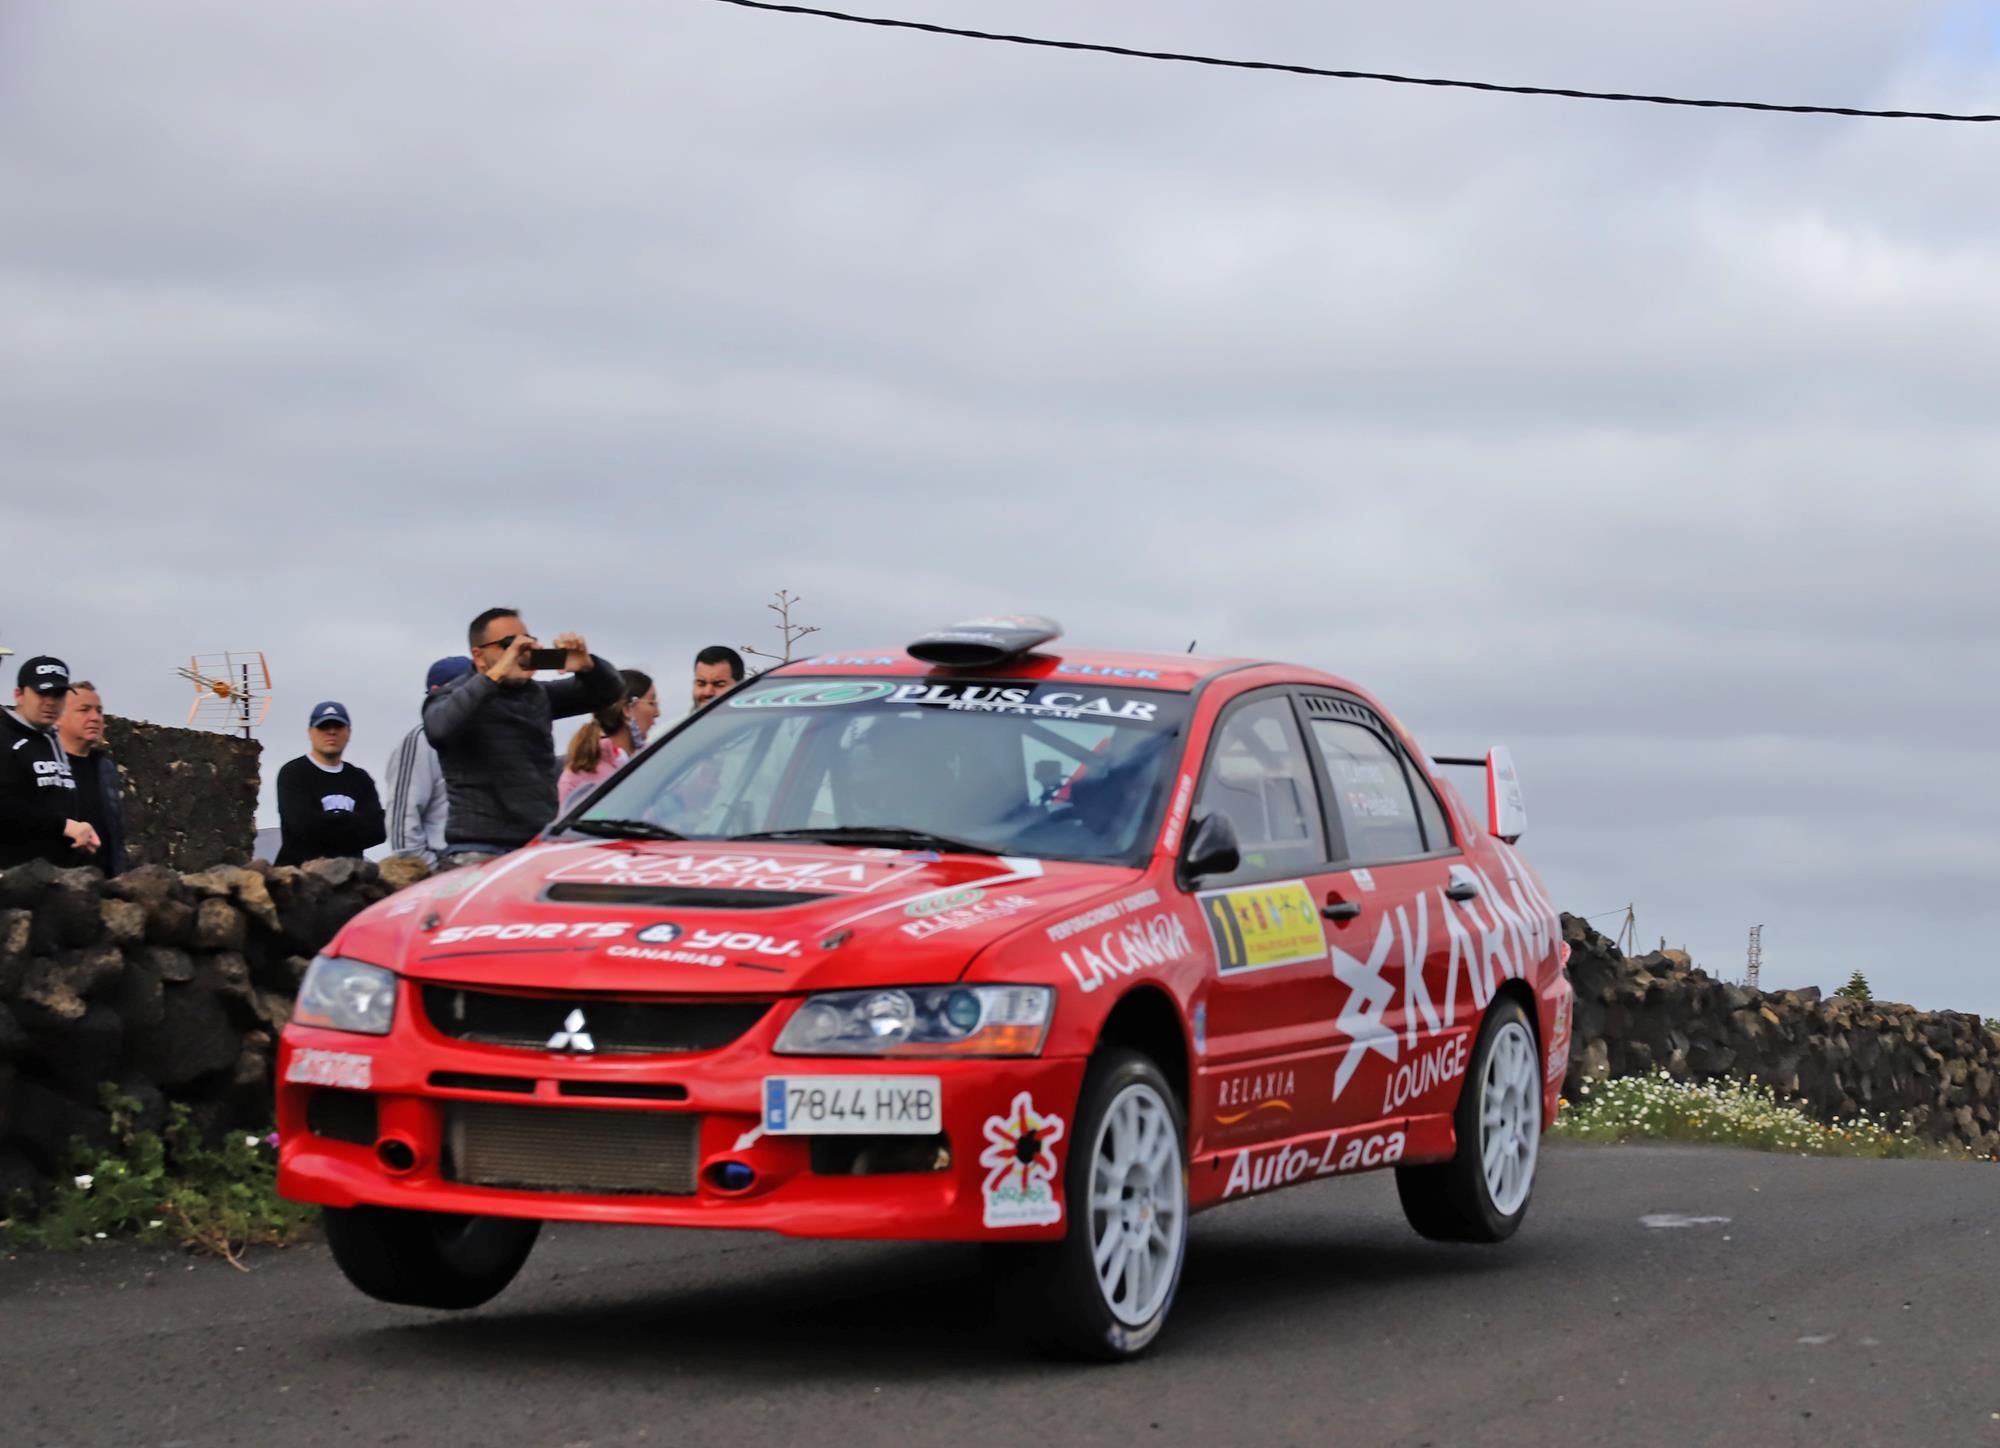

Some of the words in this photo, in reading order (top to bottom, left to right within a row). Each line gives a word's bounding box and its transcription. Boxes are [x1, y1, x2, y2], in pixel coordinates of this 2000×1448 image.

[1057, 664, 1160, 681] CLICK
[888, 683, 1031, 705] PLUS
[1039, 692, 1158, 721] CAR
[588, 854, 865, 882] KARMA
[602, 870, 822, 891] ROOFTOP
[430, 921, 634, 944] SPORTS
[638, 923, 675, 943] &
[1213, 899, 1238, 965] 1
[606, 945, 727, 967] CANARIAS
[1218, 1069, 1295, 1106] RELAXIA
[1382, 1033, 1467, 1115] LOUNGE
[788, 1088, 867, 1121] 7844
[875, 1088, 934, 1121] HXB
[1222, 1131, 1406, 1198] Auto-Laca
